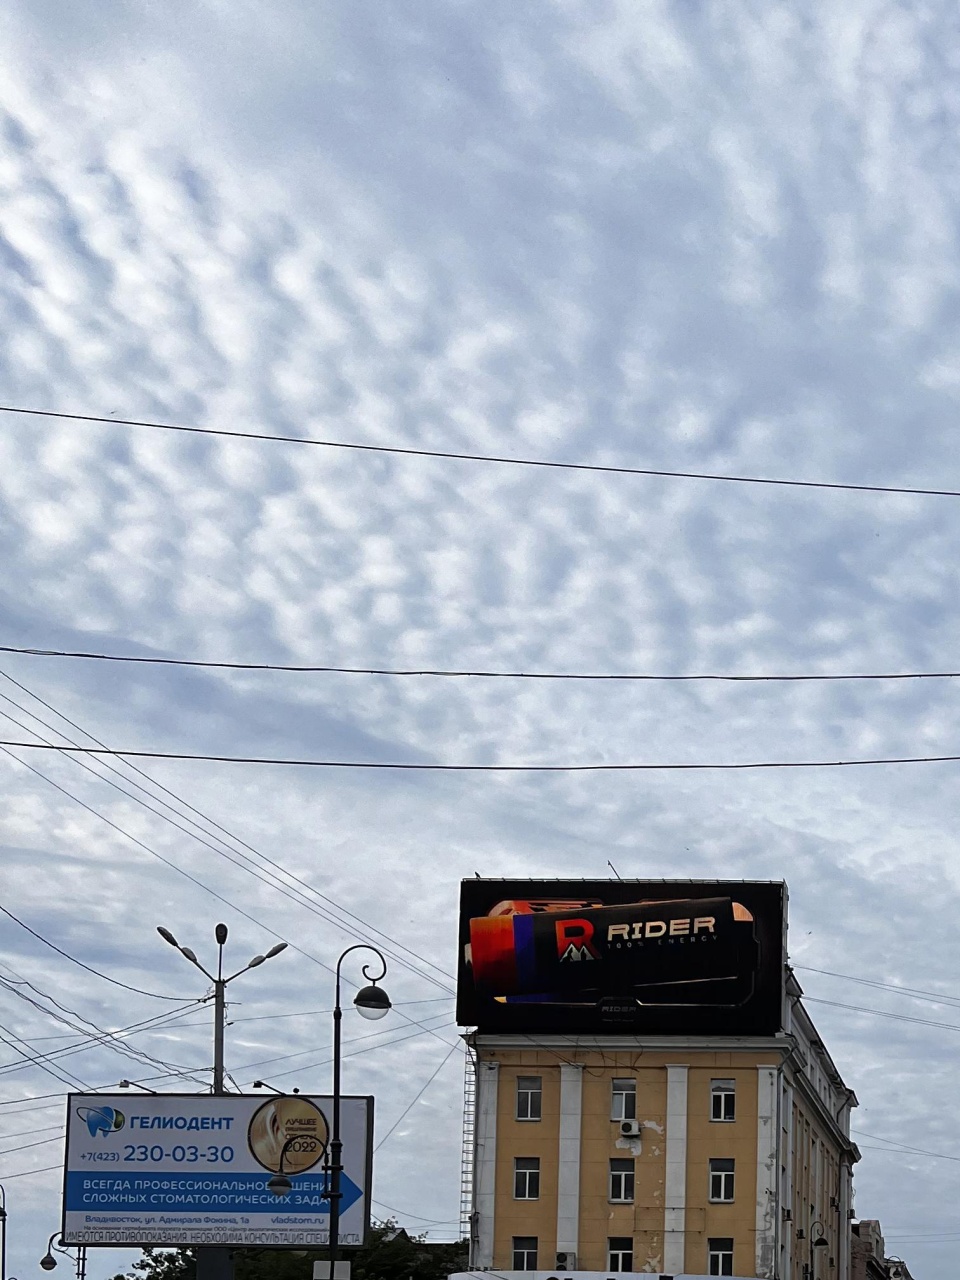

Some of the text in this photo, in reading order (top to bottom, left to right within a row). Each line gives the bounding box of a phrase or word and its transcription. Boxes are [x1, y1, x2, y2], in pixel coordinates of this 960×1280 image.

[607, 916, 716, 942] RIDER
[657, 935, 718, 946] ENERGY
[130, 1116, 234, 1131] ГЕЛИОДЕНТ
[286, 1141, 317, 1153] 2022
[80, 1145, 234, 1162] +7(423) 230-03-30
[83, 1180, 131, 1191] ВСЕГДА
[134, 1180, 271, 1191] ПРОФЕССИОНАЛЬНОЕ
[82, 1193, 331, 1206] СЛОЖНЫХ СТОМАТОЛОГИЧЕСКИХ ЗАДА
[85, 1215, 325, 1225] Владивосток, ул. Адмирала Фокина, 1а vladstom.ru
[66, 1231, 104, 1242] ИМЕЮТСЯ
[190, 1232, 242, 1243] НЕОБХОДИМА
[244, 1232, 304, 1243] КОНСУЛЬТАЦИЯ
